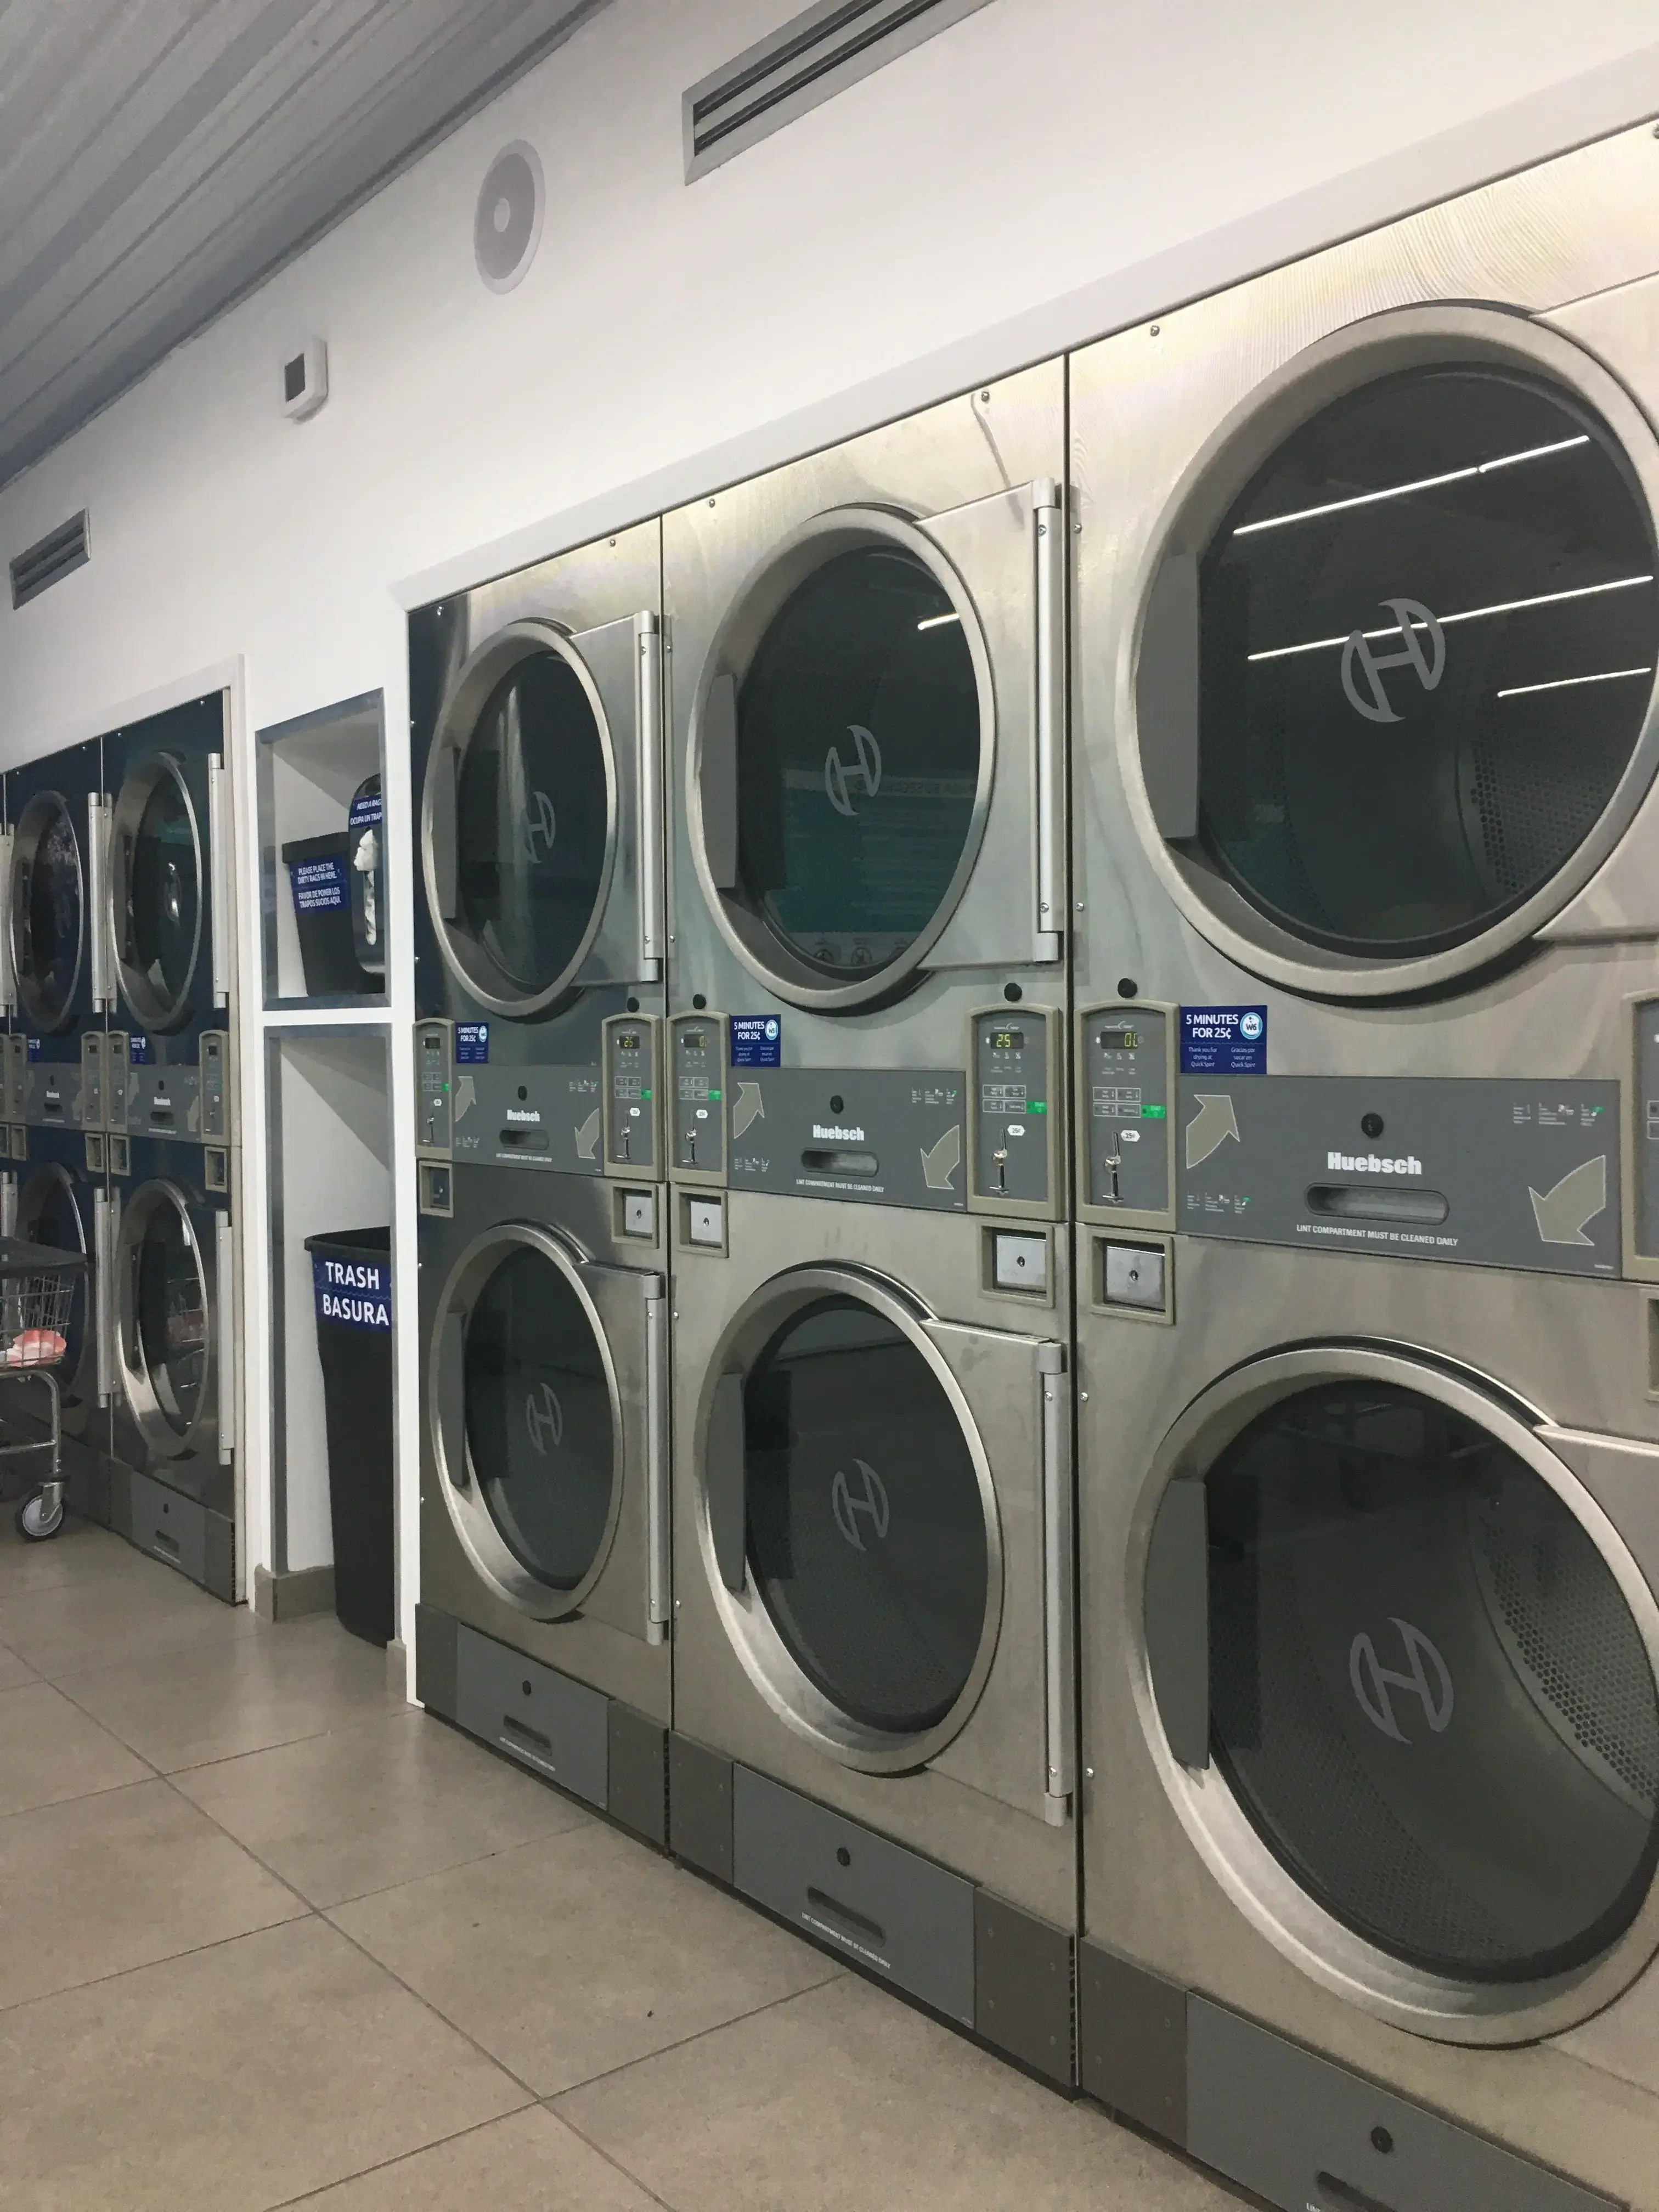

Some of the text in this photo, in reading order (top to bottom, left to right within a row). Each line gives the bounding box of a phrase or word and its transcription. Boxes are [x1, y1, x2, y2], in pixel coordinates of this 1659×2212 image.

[738, 1021, 765, 1030] MINUTES
[1186, 1014, 1239, 1025] 5 MINUTES
[737, 1031, 760, 1041] FOR 25¢
[996, 1034, 1011, 1047] 25
[1192, 1027, 1232, 1039] FOR 25¢
[812, 1124, 865, 1141] Huebsch
[1327, 1151, 1422, 1175] Huebsch
[1296, 1224, 1459, 1246] LINT COMPARTMENT MUST BE CLEANED DAILY
[325, 1261, 380, 1290] TRASH
[323, 1294, 390, 1326] BASURA
